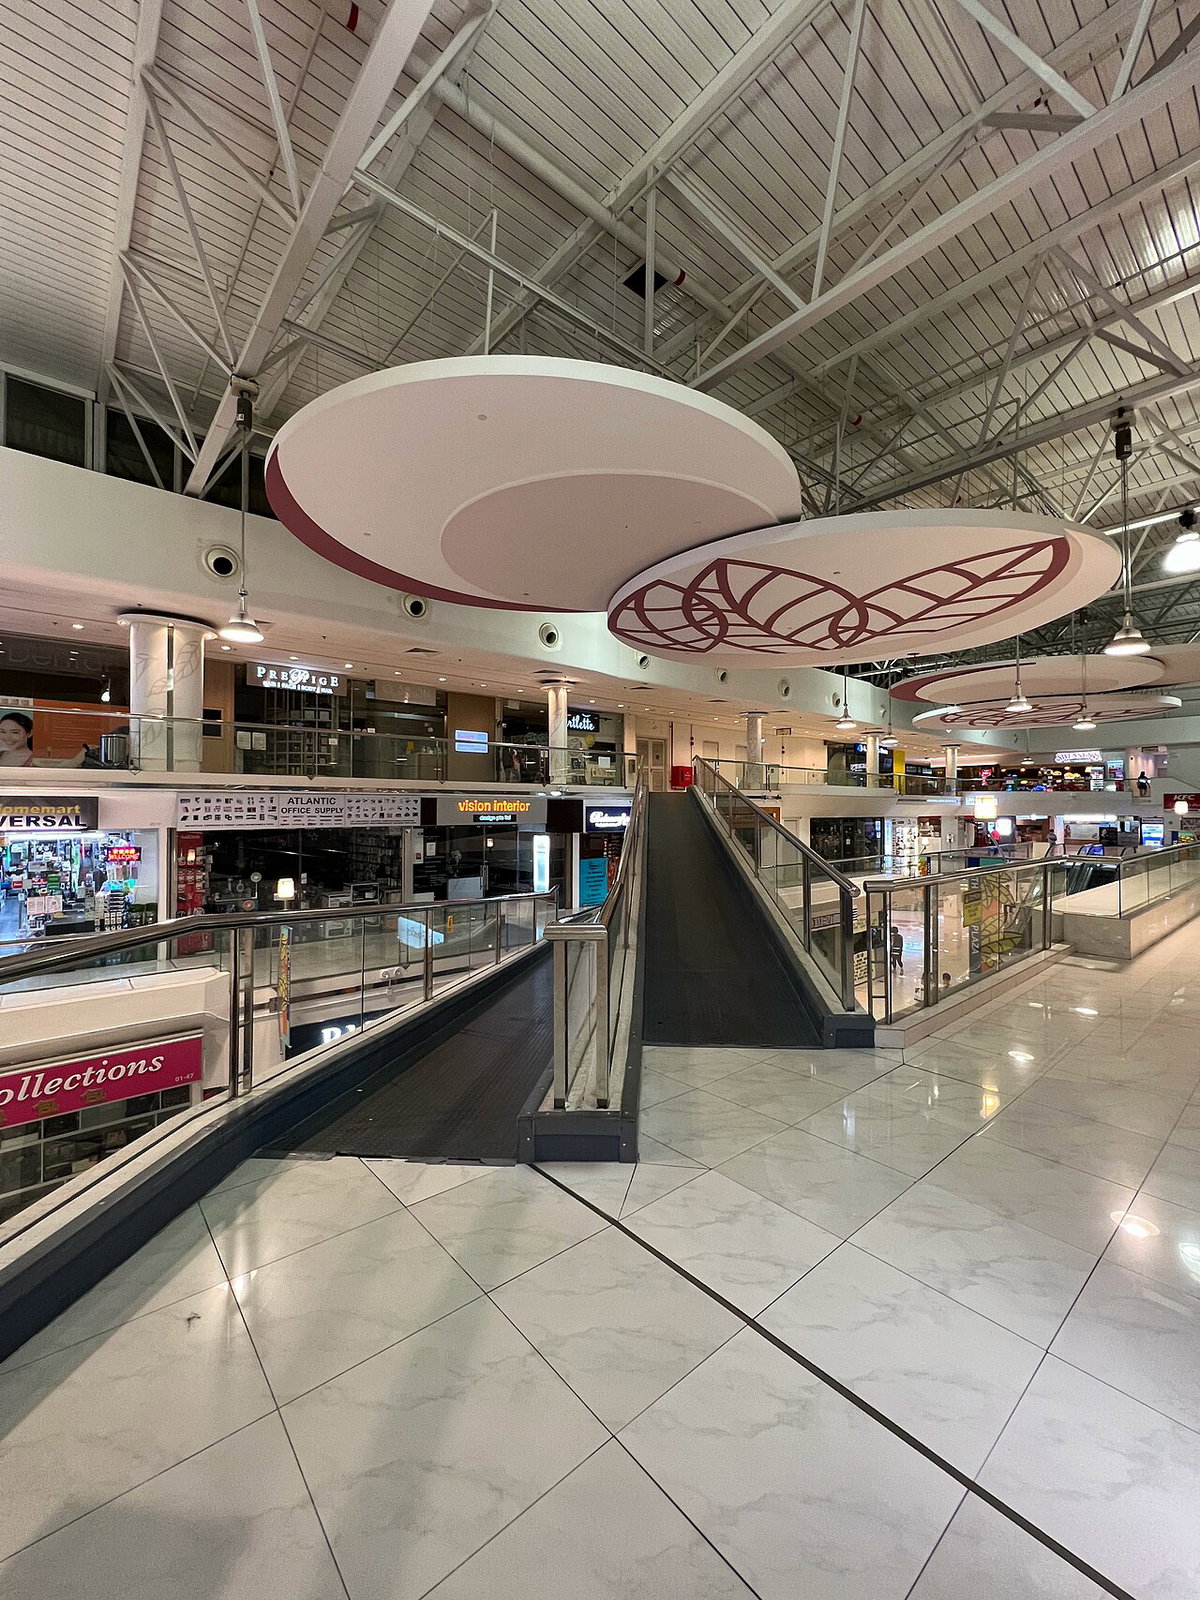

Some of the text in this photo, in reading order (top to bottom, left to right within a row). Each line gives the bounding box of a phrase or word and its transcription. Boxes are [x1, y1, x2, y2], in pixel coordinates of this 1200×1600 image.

[287, 797, 337, 805] ATLANTIC
[458, 800, 531, 812] vision interior
[0, 804, 80, 814] omemart
[971, 924, 980, 954] PLAZA
[175, 1072, 195, 1083] 01-47
